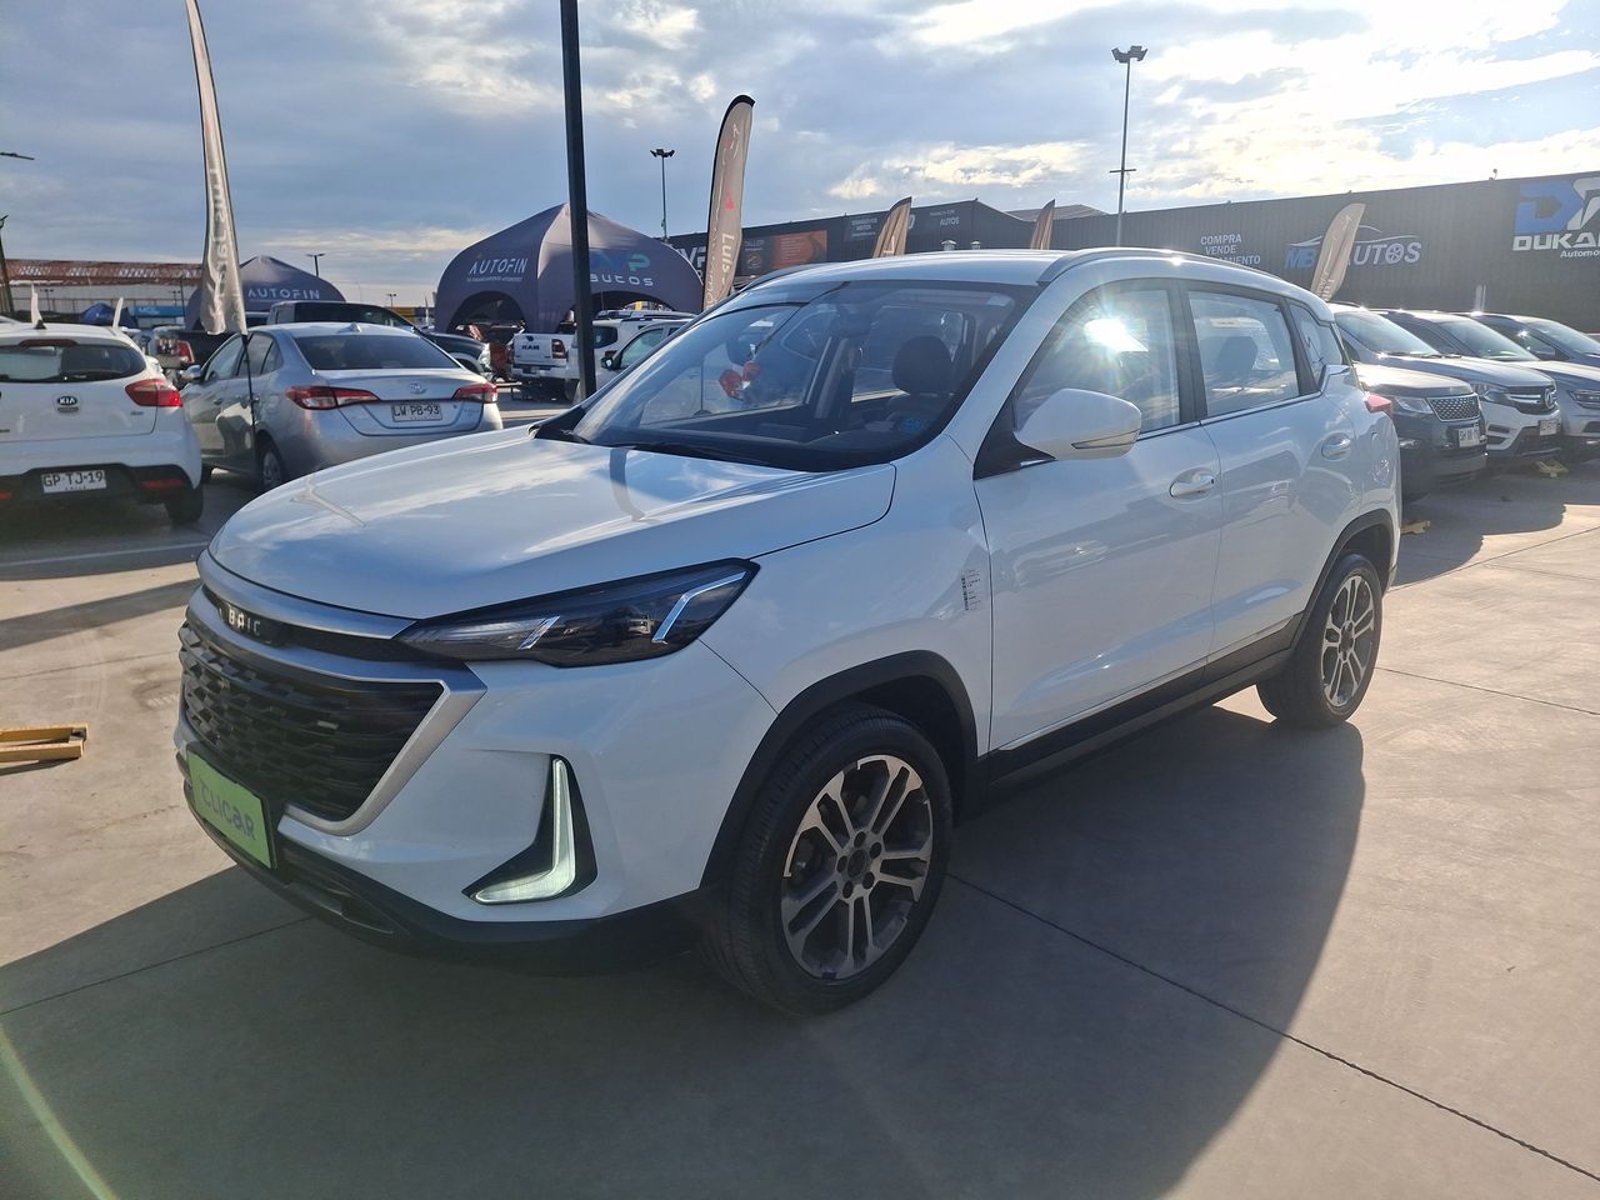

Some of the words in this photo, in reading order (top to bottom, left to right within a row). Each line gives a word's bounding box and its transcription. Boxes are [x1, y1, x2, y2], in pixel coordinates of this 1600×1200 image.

[1200, 233, 1242, 246] COMPRA
[1512, 232, 1600, 251] DUKA
[1205, 244, 1237, 255] VENDE
[1349, 241, 1422, 266] UTOS
[1560, 249, 1600, 259] Automo
[469, 257, 529, 275] AUTOFIN
[247, 288, 320, 300] AUTOFIN
[59, 397, 76, 405] KIA
[228, 608, 261, 637] BAIC
